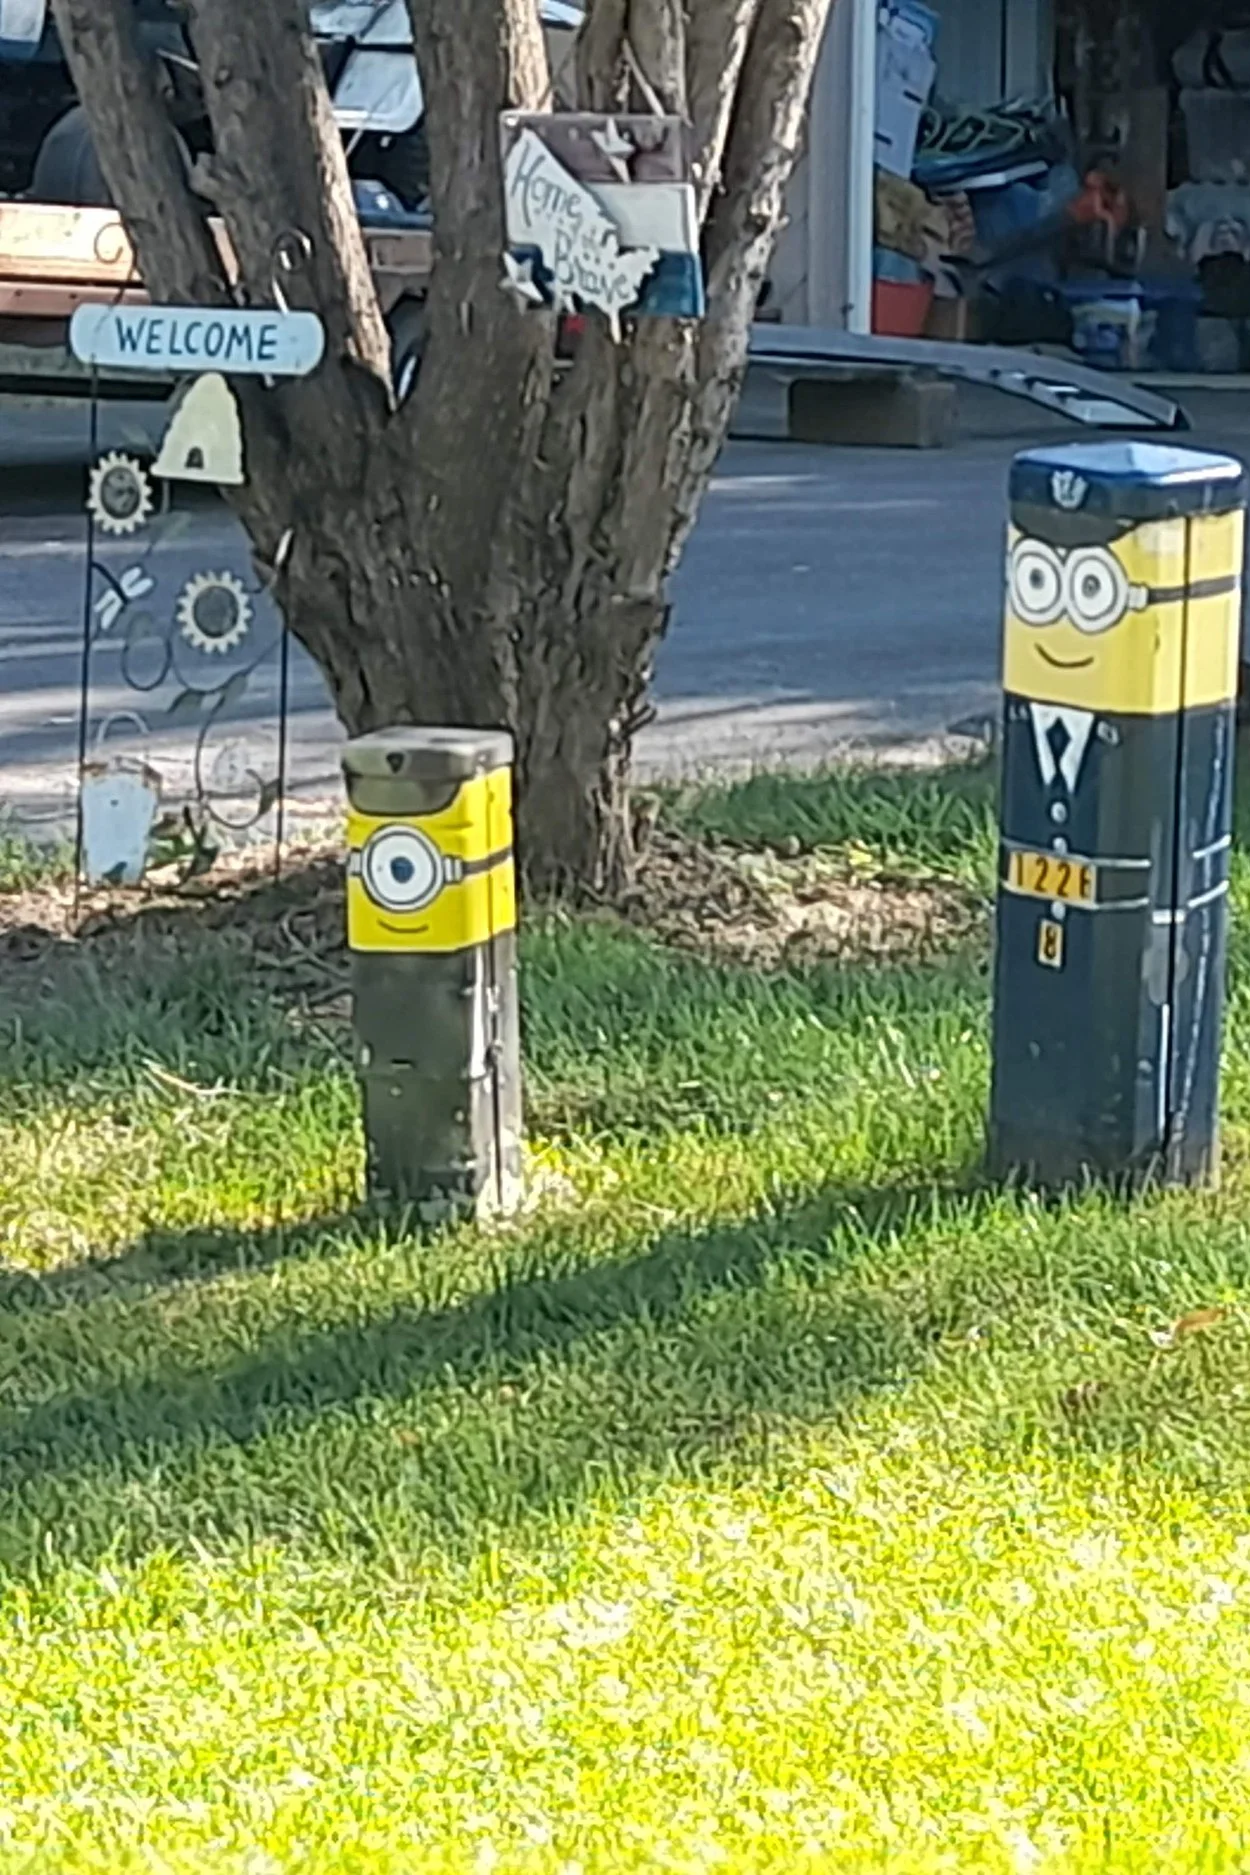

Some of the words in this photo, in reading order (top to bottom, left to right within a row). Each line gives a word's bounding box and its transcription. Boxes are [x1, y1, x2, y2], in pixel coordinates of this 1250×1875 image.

[510, 140, 583, 228] Home
[554, 227, 631, 304] Brave
[115, 316, 278, 361] WELCOME
[1044, 925, 1057, 960] 8
